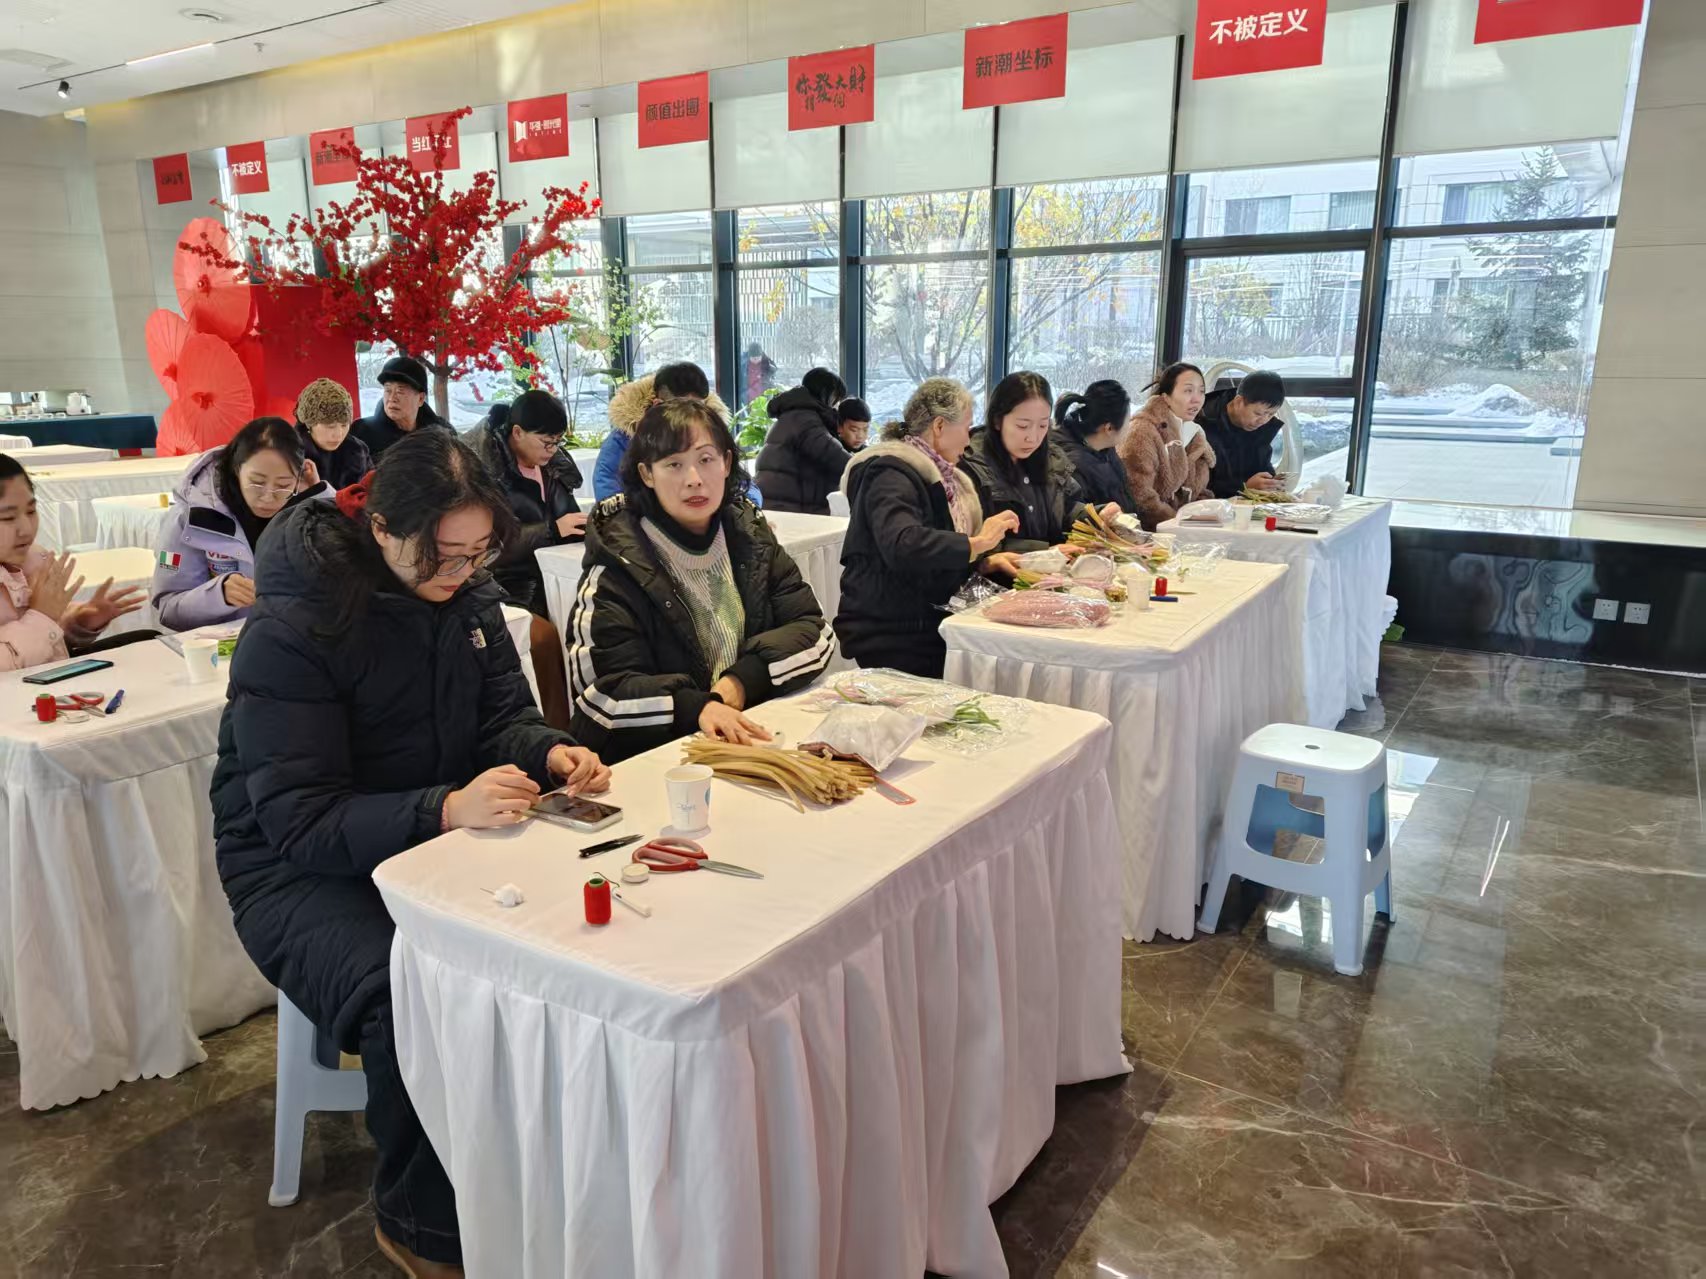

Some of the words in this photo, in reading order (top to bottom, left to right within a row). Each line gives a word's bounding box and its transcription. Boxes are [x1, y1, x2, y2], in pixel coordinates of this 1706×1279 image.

[1208, 8, 1308, 45] 不被定义
[975, 46, 1055, 78] 新潮坐标
[645, 97, 699, 121] 颜值出圈
[231, 160, 263, 177] 不被定义
[208, 552, 235, 565] VIS
